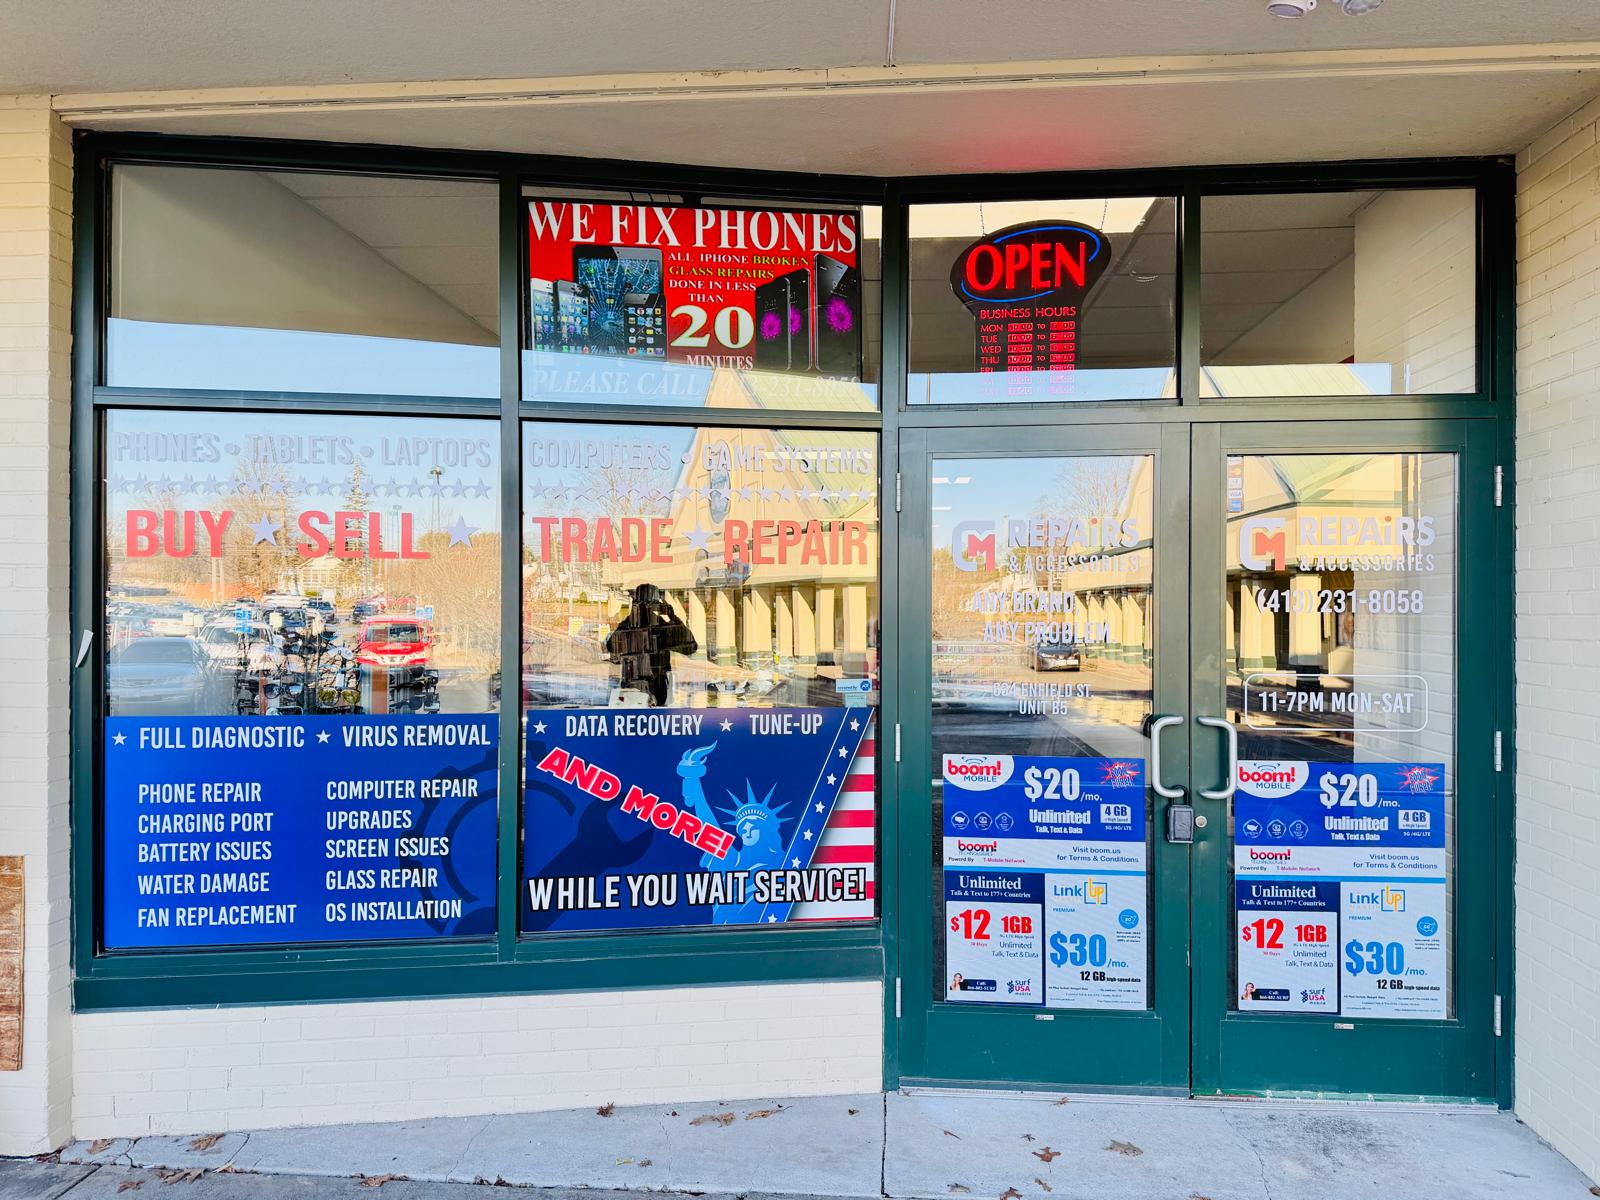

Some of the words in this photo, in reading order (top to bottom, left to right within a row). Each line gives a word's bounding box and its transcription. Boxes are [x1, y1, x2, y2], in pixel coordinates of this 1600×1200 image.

[529, 202, 596, 243] WE
[610, 205, 681, 247] FIX
[693, 208, 856, 254] PHONES
[668, 252, 693, 261] ALL
[700, 253, 748, 264] IPHONE
[753, 255, 809, 266] BROKEN
[966, 242, 1086, 290] OPEN
[669, 266, 713, 276] GLASS
[717, 268, 774, 278] REPAIRS
[669, 279, 706, 289] DONE
[709, 281, 722, 290] IN
[726, 282, 756, 291] LESS
[688, 293, 724, 303] THAN
[980, 308, 1031, 319] BUSINESS
[1035, 307, 1076, 317] HOURS
[670, 304, 755, 349] 20
[981, 324, 1003, 332] MON
[981, 335, 998, 343] TUE
[981, 346, 1002, 354] WED
[686, 355, 754, 370] MINUTES
[981, 356, 1000, 364] THU
[533, 370, 629, 395] PLEASE
[636, 372, 704, 397] CALL
[112, 431, 221, 463] PHONES
[245, 432, 355, 465] TABLETS
[381, 436, 492, 468] LAPTOPS
[528, 438, 672, 471] COMPUTERS
[702, 444, 765, 473] GAME
[773, 446, 873, 475] SYSTEMS
[126, 510, 233, 558] BUY
[297, 511, 430, 560] SELL
[532, 517, 674, 563] TRADE
[723, 519, 868, 565] REPAIR
[1009, 555, 1019, 572] &
[1025, 554, 1139, 572] ACCESSORIES
[1299, 555, 1310, 572] &
[1316, 554, 1434, 572] ACCESSORIES
[972, 591, 1006, 613] ANY
[1257, 588, 1314, 615] (413)
[1318, 589, 1424, 614] 231-8058
[983, 621, 1018, 643] ANY
[1025, 621, 1111, 644] PROBLEM
[1021, 683, 1073, 698] ENFIELD
[1019, 700, 1047, 715] UNIT
[1052, 700, 1068, 715] B5
[1259, 692, 1324, 713] 11-7PM
[1331, 692, 1414, 713] MON-SAT
[565, 715, 609, 737] DATA
[614, 714, 704, 737] RECOVERY
[749, 713, 823, 735] TUNE-UP
[139, 727, 186, 749] FULL
[192, 725, 305, 749] DIAGNOSTIC
[342, 725, 398, 748] VIRUS
[403, 724, 491, 747] REMOVAL
[948, 759, 1001, 776] boom!
[1239, 766, 1295, 783] boom!
[964, 775, 997, 783] MOBILE
[138, 784, 196, 804] PHONE
[202, 782, 262, 802] REPAIR
[326, 779, 415, 801] COMPUTER
[420, 778, 478, 798] REPAIR
[537, 746, 622, 802] AND
[620, 784, 737, 860] MORE!
[1105, 805, 1111, 816] 4
[1114, 806, 1128, 816] GB
[138, 813, 225, 834] CHARGING
[230, 811, 274, 832] PORT
[326, 809, 412, 830] UPGRADES
[1029, 809, 1091, 824] Unlimited
[1324, 816, 1388, 831] Unlimited
[1403, 812, 1409, 822] 4
[1412, 812, 1426, 822] GB
[1069, 826, 1083, 834] Data
[138, 842, 211, 863] BATTERY
[215, 840, 272, 861] ISSUES
[325, 838, 389, 859] SCREEN
[394, 837, 449, 857] ISSUES
[958, 839, 997, 852] boom!
[1250, 848, 1291, 860] boom!
[138, 874, 194, 895] WATER
[200, 872, 270, 894] DAMAGE
[325, 869, 376, 891] GLASS
[380, 867, 438, 889] REPAIR
[959, 875, 1022, 890] Unlimited
[528, 875, 620, 911] WHILE
[627, 873, 677, 907] YOU
[685, 870, 749, 905] WAIT
[754, 867, 867, 903] SERVICE!
[1054, 885, 1083, 897] Link
[1251, 885, 1316, 898] Unlimited
[1349, 892, 1379, 904] Link
[138, 906, 169, 928] FAN
[175, 904, 297, 927] REPLACEMENT
[325, 902, 346, 922] OS
[351, 899, 462, 922] INSTALLATION
[950, 909, 991, 940] $12
[1001, 916, 1032, 934] 1GB
[1242, 918, 1285, 949] $12
[1294, 924, 1327, 943] 1GB
[1000, 941, 1032, 949] Unlimited
[1080, 971, 1090, 981] 12
[1093, 971, 1106, 982] GB
[1376, 979, 1388, 989] 12
[1390, 979, 1403, 990] GB
